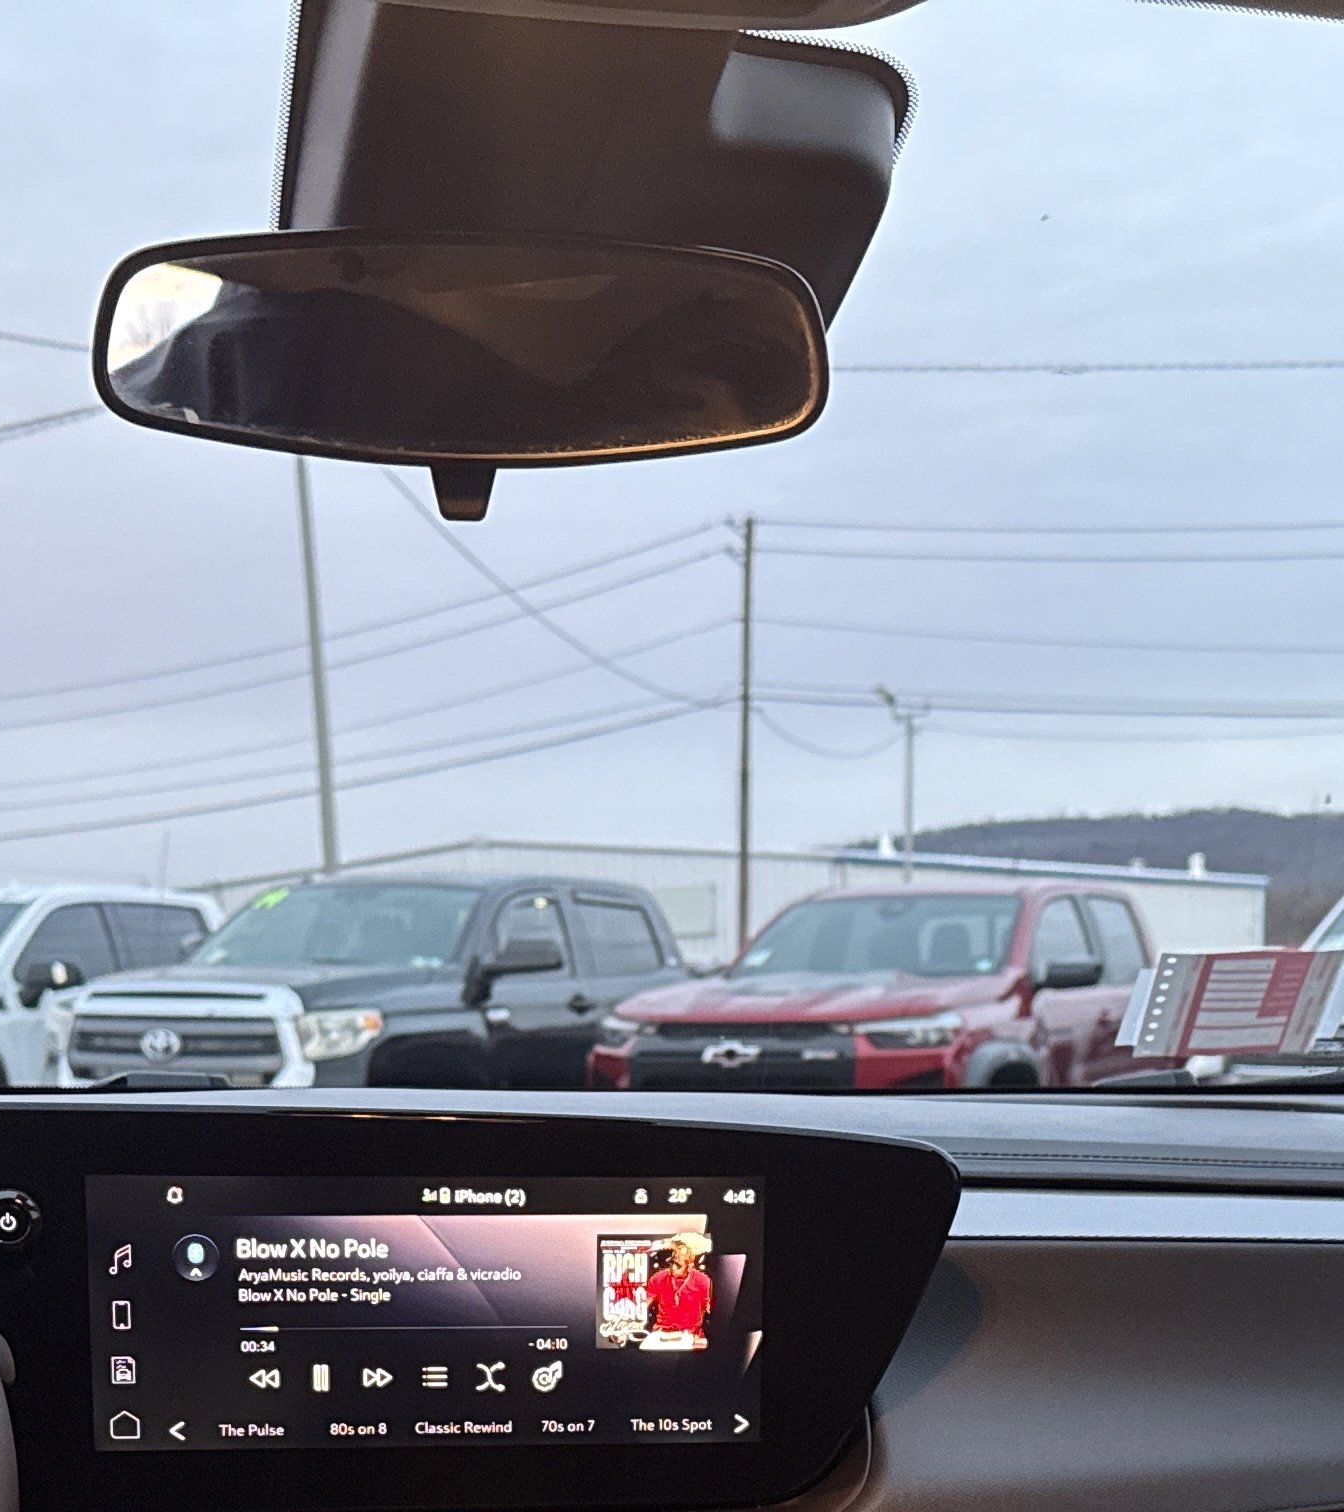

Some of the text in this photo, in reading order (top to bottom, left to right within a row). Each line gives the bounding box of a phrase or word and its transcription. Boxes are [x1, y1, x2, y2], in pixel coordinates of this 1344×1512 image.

[454, 1188, 526, 1207] iPhone (2)
[723, 1188, 755, 1204] 4:42
[236, 1237, 389, 1259] Blow X No Pole
[237, 1267, 309, 1285] AryaMusic
[311, 1267, 371, 1283] Records,
[417, 1266, 454, 1281] ciaffa
[456, 1267, 468, 1281] &
[470, 1266, 522, 1281] vicradio
[602, 1252, 649, 1284] RICH
[238, 1288, 272, 1303] Blow
[273, 1288, 284, 1302] X
[286, 1288, 307, 1302] No
[309, 1288, 339, 1302] Pole
[349, 1287, 391, 1305] Single
[240, 1340, 276, 1352] 00:34
[218, 1423, 285, 1437] The Pulse
[329, 1422, 388, 1436] 80s on 8
[414, 1420, 513, 1434] Classic Rewind
[541, 1419, 596, 1433] 70s on 7
[629, 1418, 713, 1434] The 10s Spot
